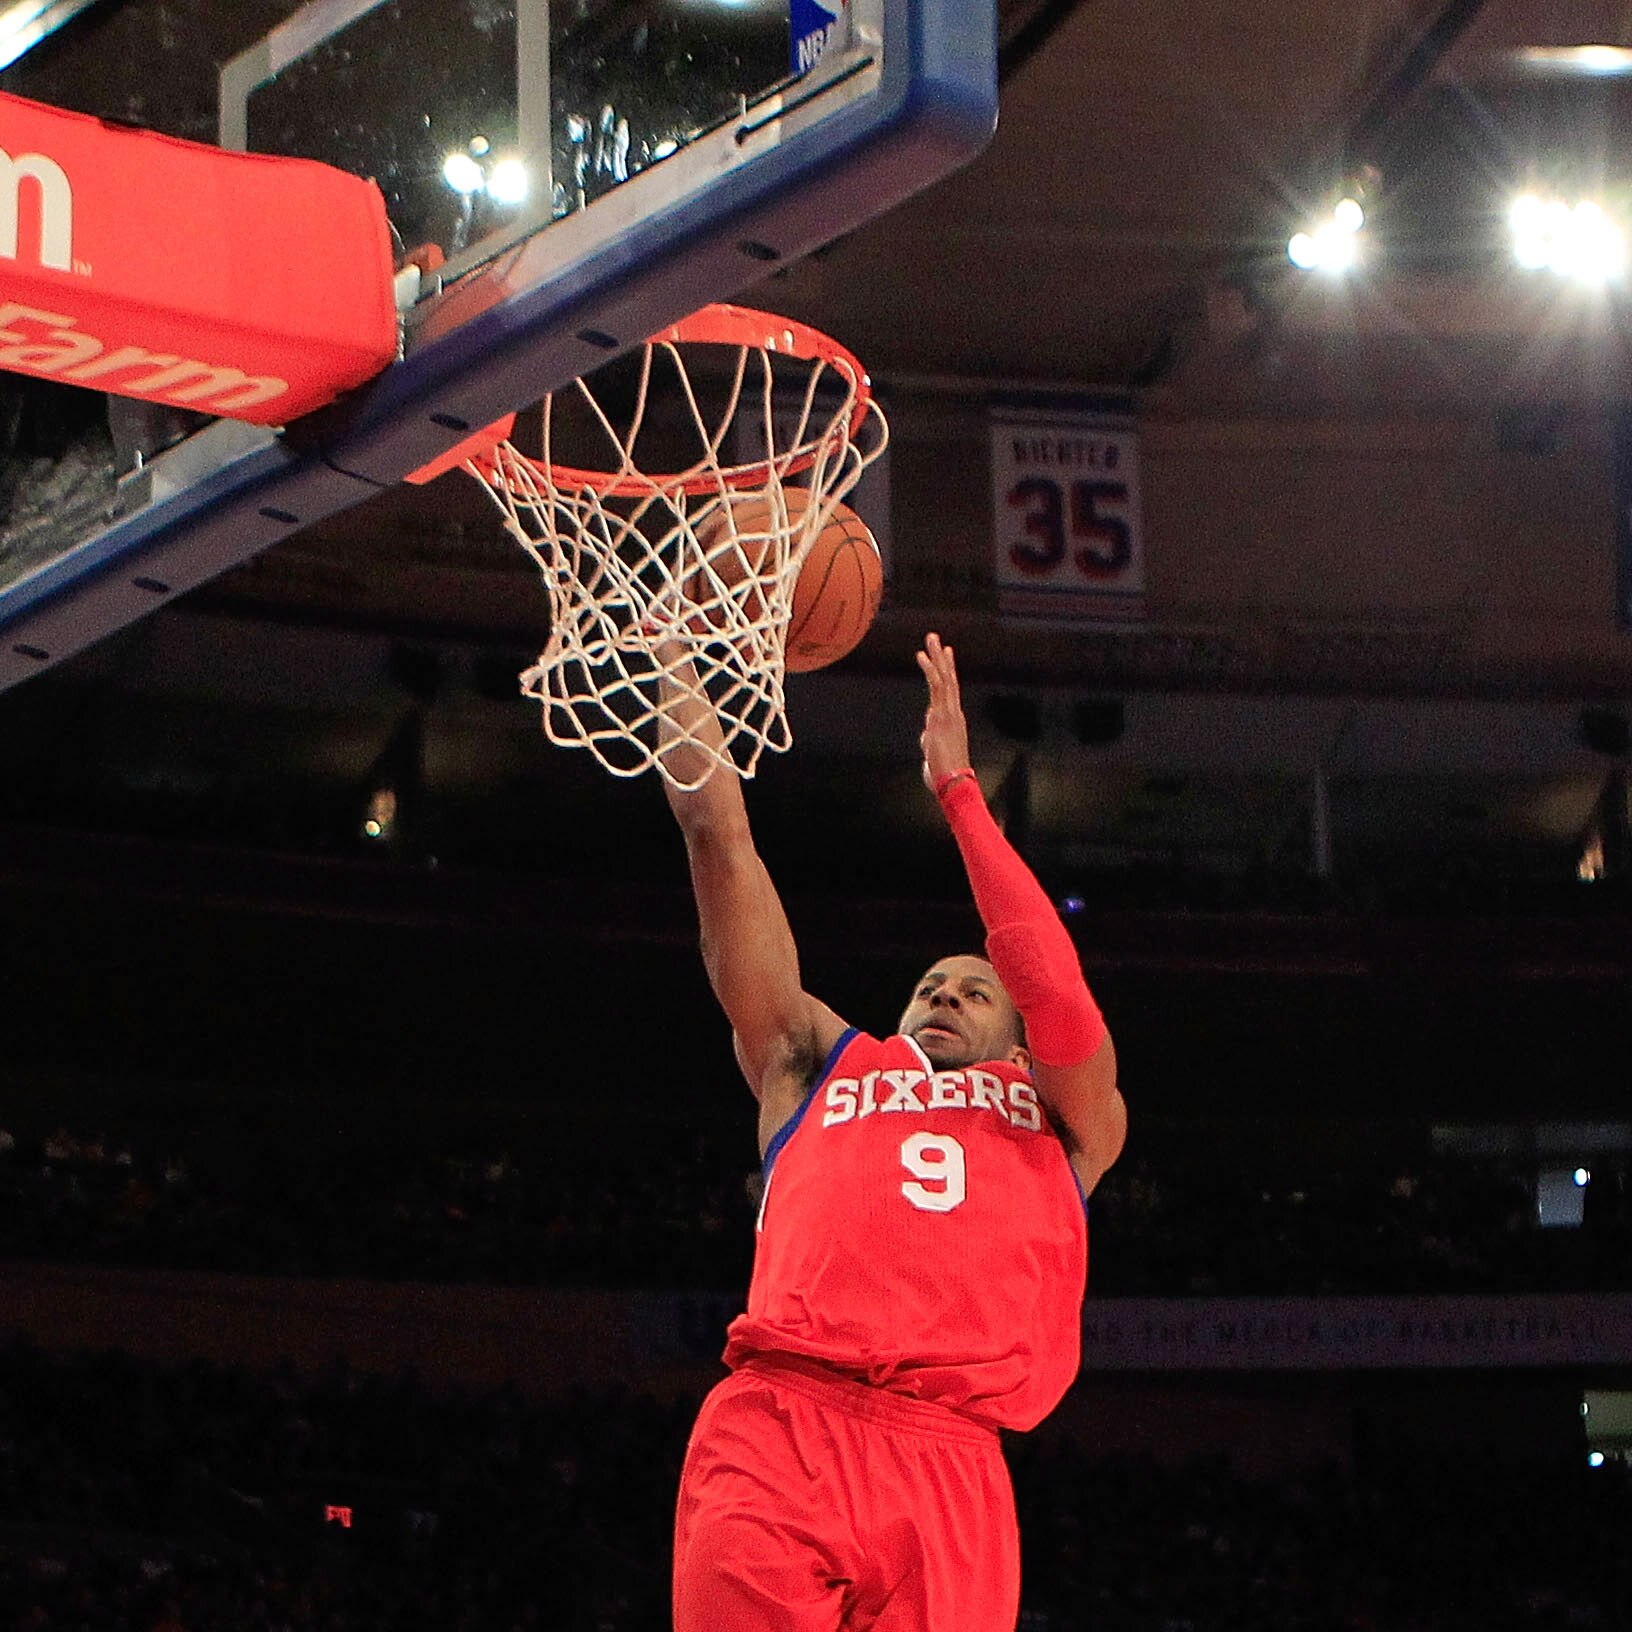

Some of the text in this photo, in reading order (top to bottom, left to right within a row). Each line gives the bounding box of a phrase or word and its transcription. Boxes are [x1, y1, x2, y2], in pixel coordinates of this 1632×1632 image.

[1007, 476, 1132, 581] 35
[822, 1068, 1042, 1131] SIXERS
[900, 1131, 967, 1213] 9
